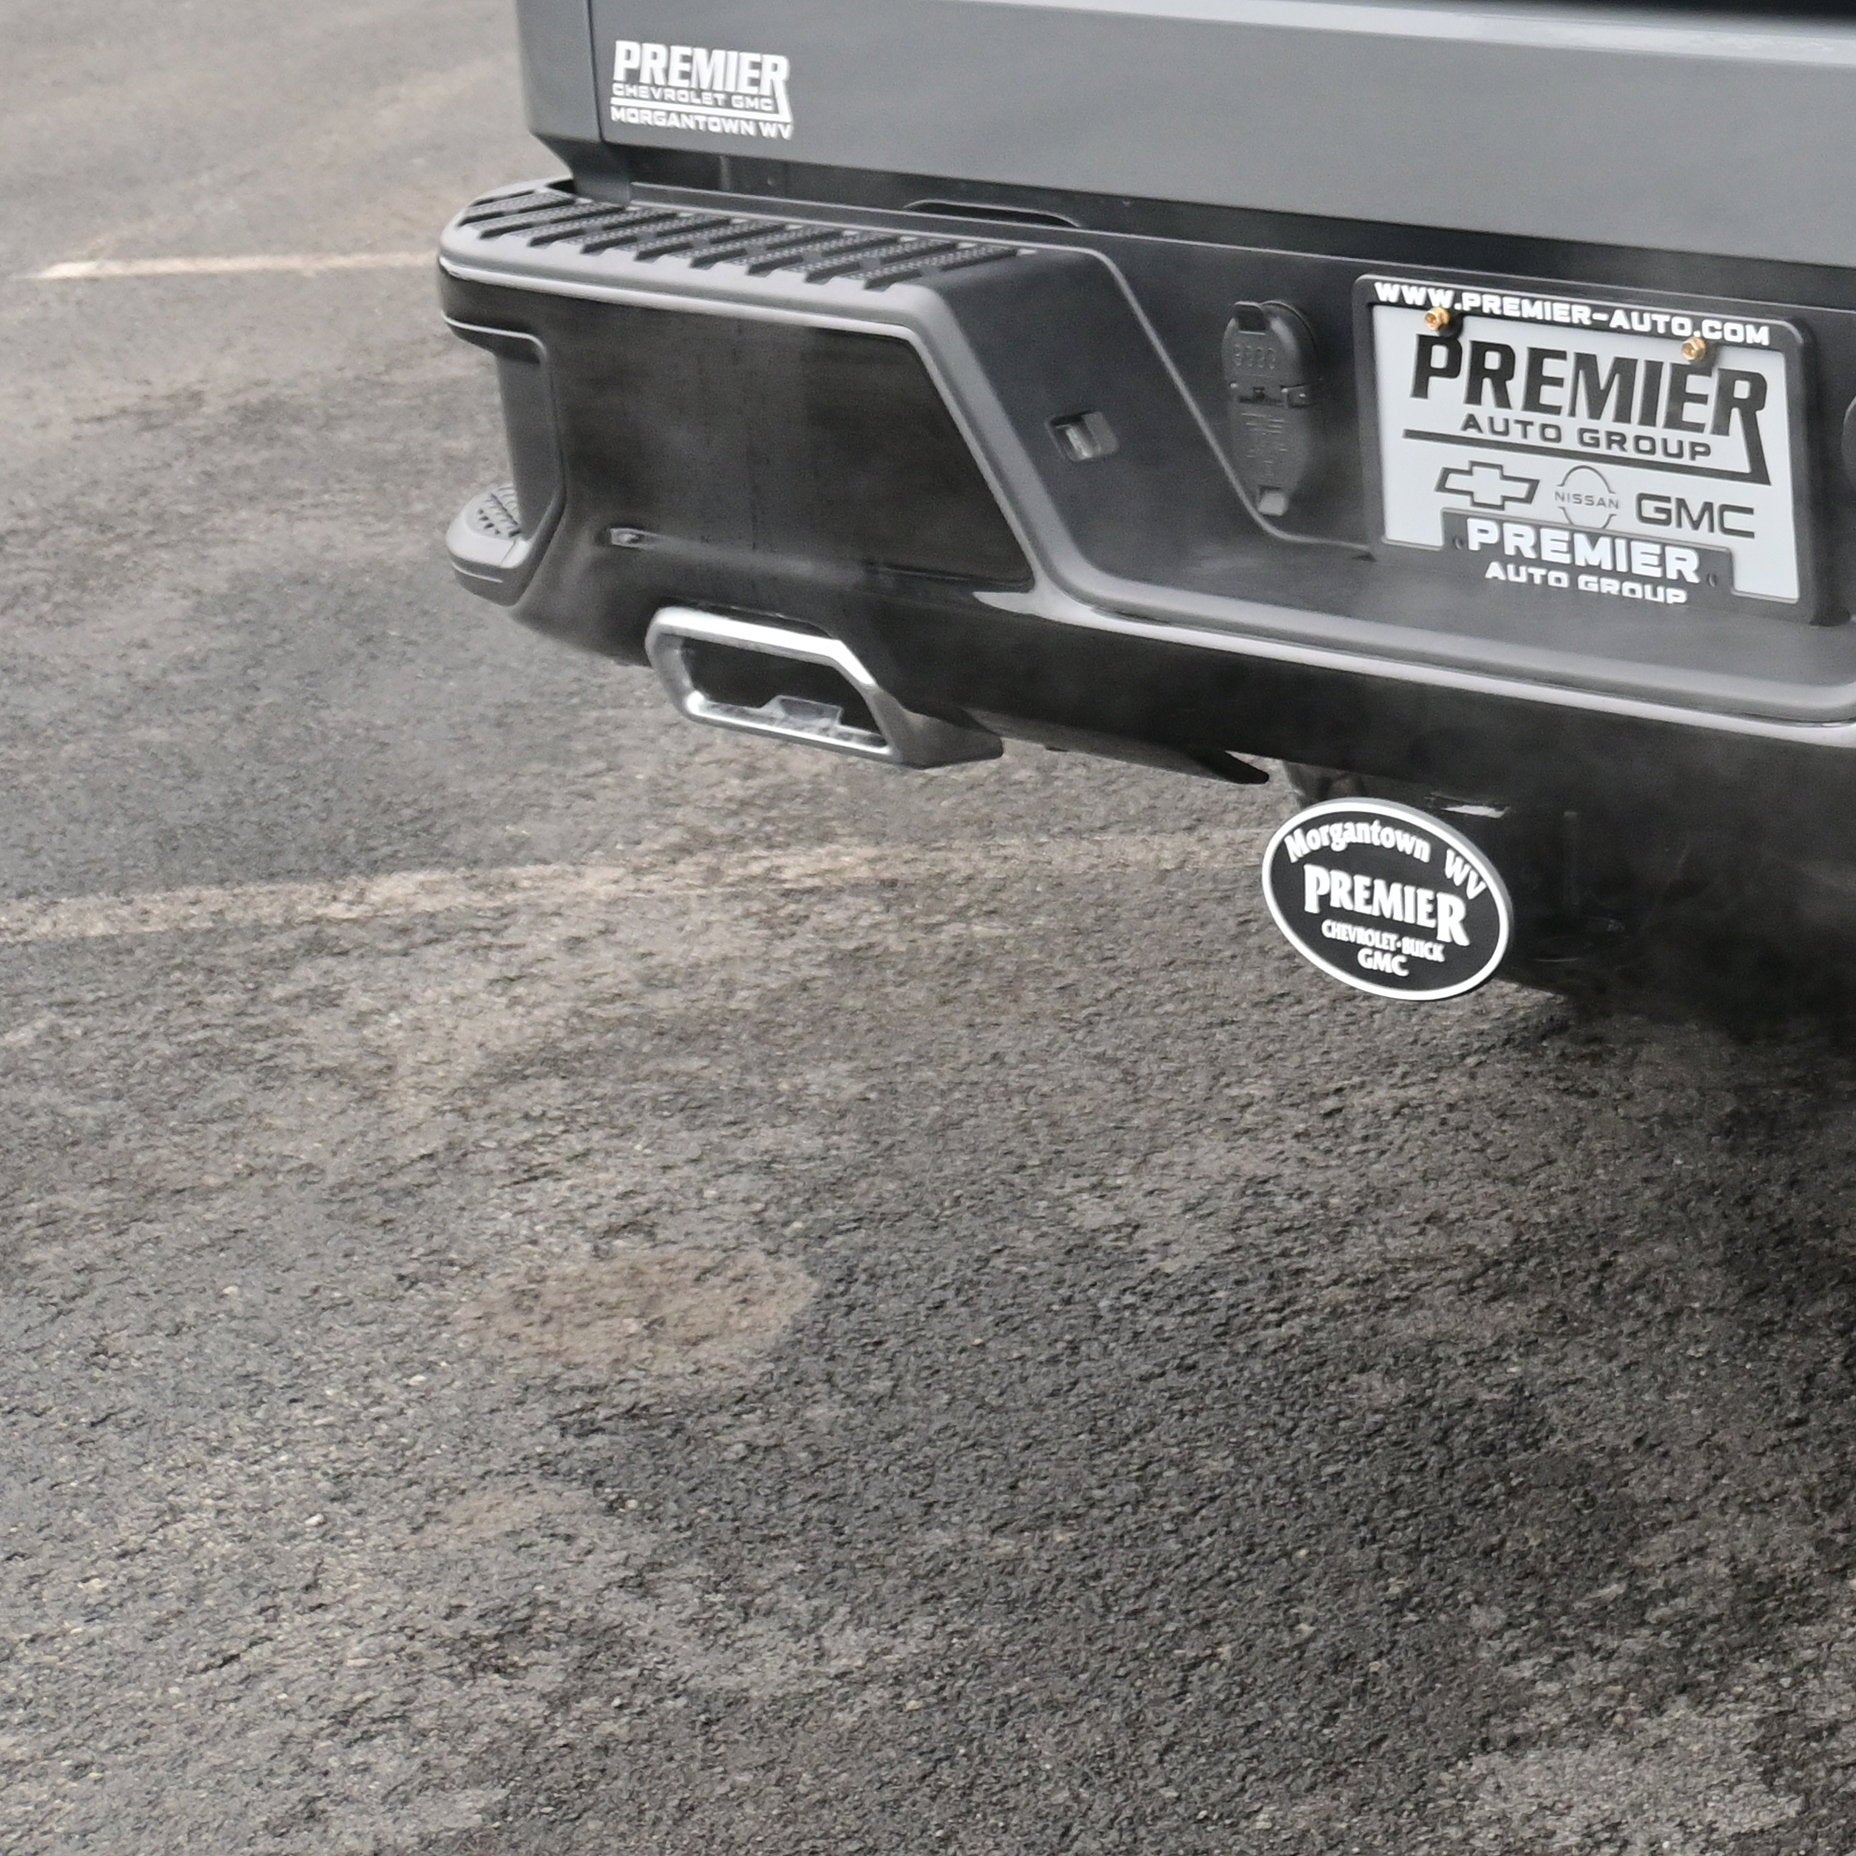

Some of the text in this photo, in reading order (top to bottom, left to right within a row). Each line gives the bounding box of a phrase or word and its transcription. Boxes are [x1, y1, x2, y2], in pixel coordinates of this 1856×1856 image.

[611, 82, 774, 112] CHEVROLET GMC
[612, 40, 791, 101] PREMIER
[610, 106, 794, 141] MORGANTOWN WV
[1374, 282, 1770, 346] WWW.PREMIER-AUTO.COM
[1410, 333, 1770, 446] PREMIER
[1460, 413, 1712, 461] AUTO GROUP
[1554, 490, 1755, 539] NISSAN GMC
[1466, 517, 1700, 584] PREMIER
[1484, 561, 1688, 605] AUTO GROUP
[1284, 819, 1487, 900] Morgantown WV
[1303, 863, 1471, 947] PREMIER
[1357, 947, 1410, 977] GMC
